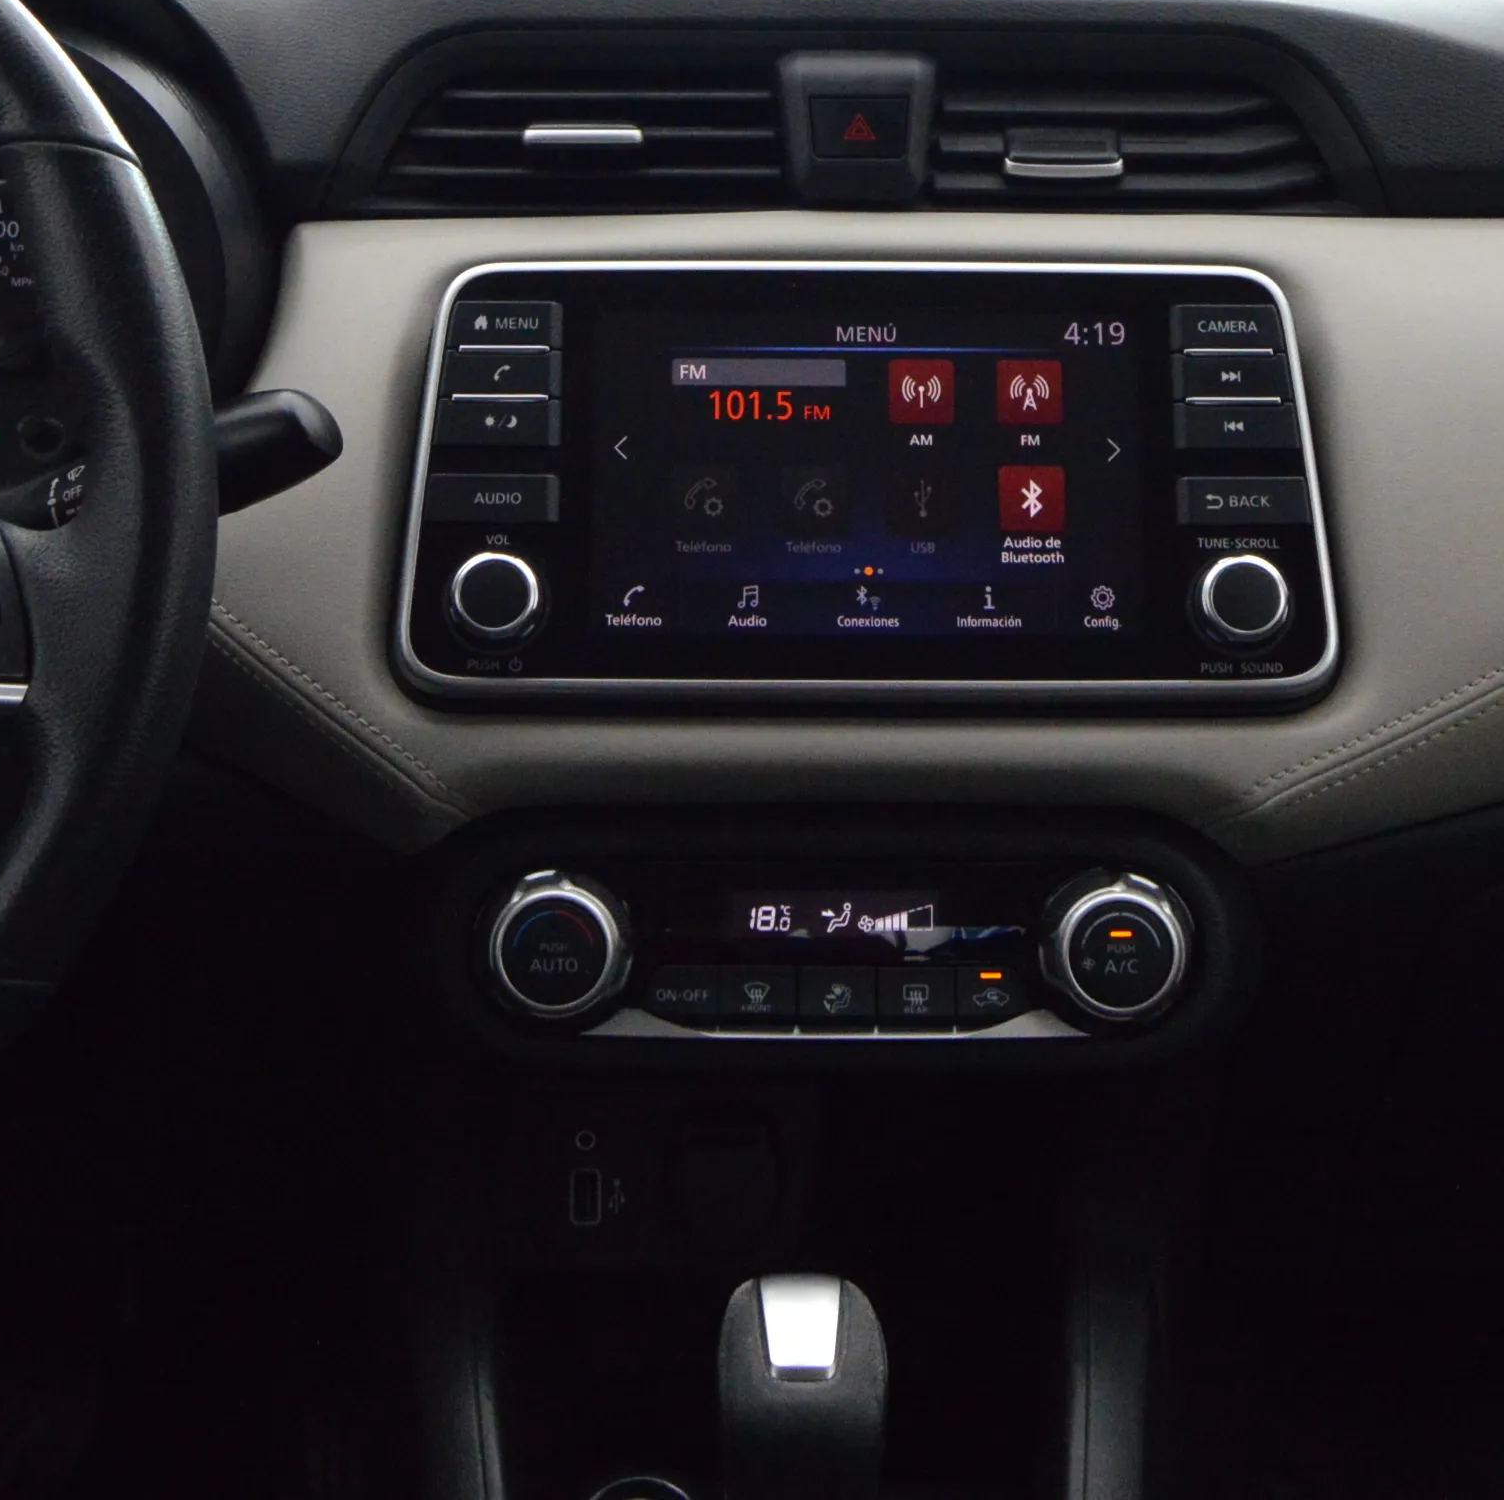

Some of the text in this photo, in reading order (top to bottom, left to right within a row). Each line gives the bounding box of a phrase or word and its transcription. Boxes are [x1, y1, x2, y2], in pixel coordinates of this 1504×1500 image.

[495, 317, 539, 330] MENU
[1197, 320, 1259, 333] CAMERA
[836, 320, 897, 343] MENÚ
[1063, 321, 1126, 346] 4:19
[679, 364, 707, 380] FM
[709, 389, 831, 421] 101.5 FM
[909, 434, 933, 446] AM
[1020, 434, 1041, 446] FM
[473, 491, 522, 505] AUDIO
[1228, 495, 1270, 508] BACK
[486, 534, 510, 546] VOL
[1003, 536, 1062, 549] Audio de
[910, 542, 935, 554] USB
[1001, 551, 1065, 564] Bluetooth
[605, 613, 663, 627] Teléfono
[727, 614, 768, 628] Audio
[836, 615, 900, 628] Conexiones
[956, 615, 1022, 628] Información
[1083, 615, 1122, 631] Config.
[466, 658, 500, 671] PUSH
[1200, 662, 1284, 674] PUSH SOUND
[1106, 943, 1136, 954] PUSH
[530, 957, 579, 973] AUTO
[1104, 958, 1138, 974] A/C
